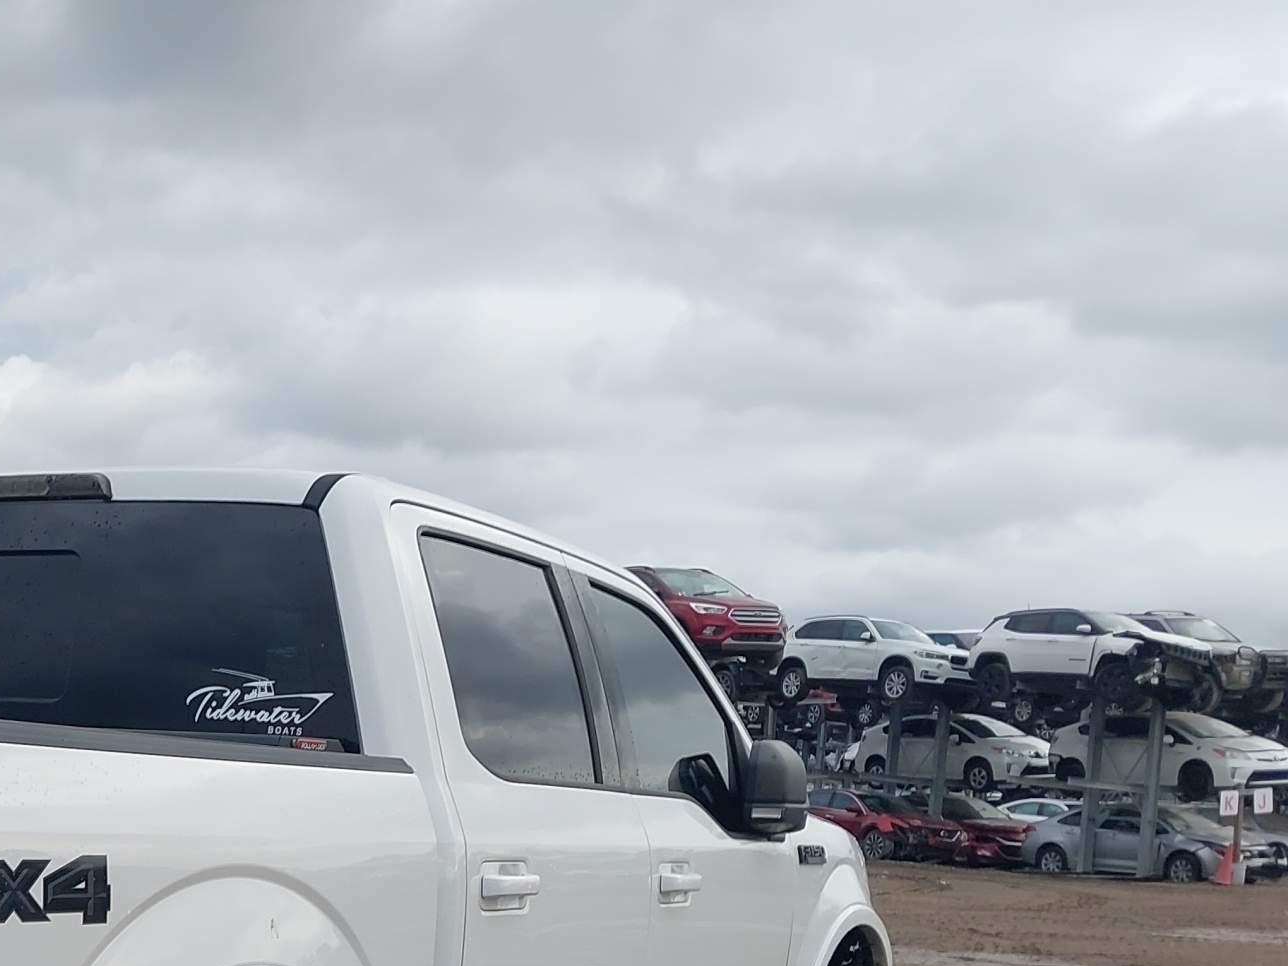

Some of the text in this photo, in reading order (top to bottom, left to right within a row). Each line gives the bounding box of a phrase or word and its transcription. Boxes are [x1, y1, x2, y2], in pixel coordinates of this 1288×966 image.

[186, 686, 314, 724] Tidewater
[267, 725, 303, 736] BOATS
[1224, 795, 1234, 812] K
[1258, 793, 1267, 809] J
